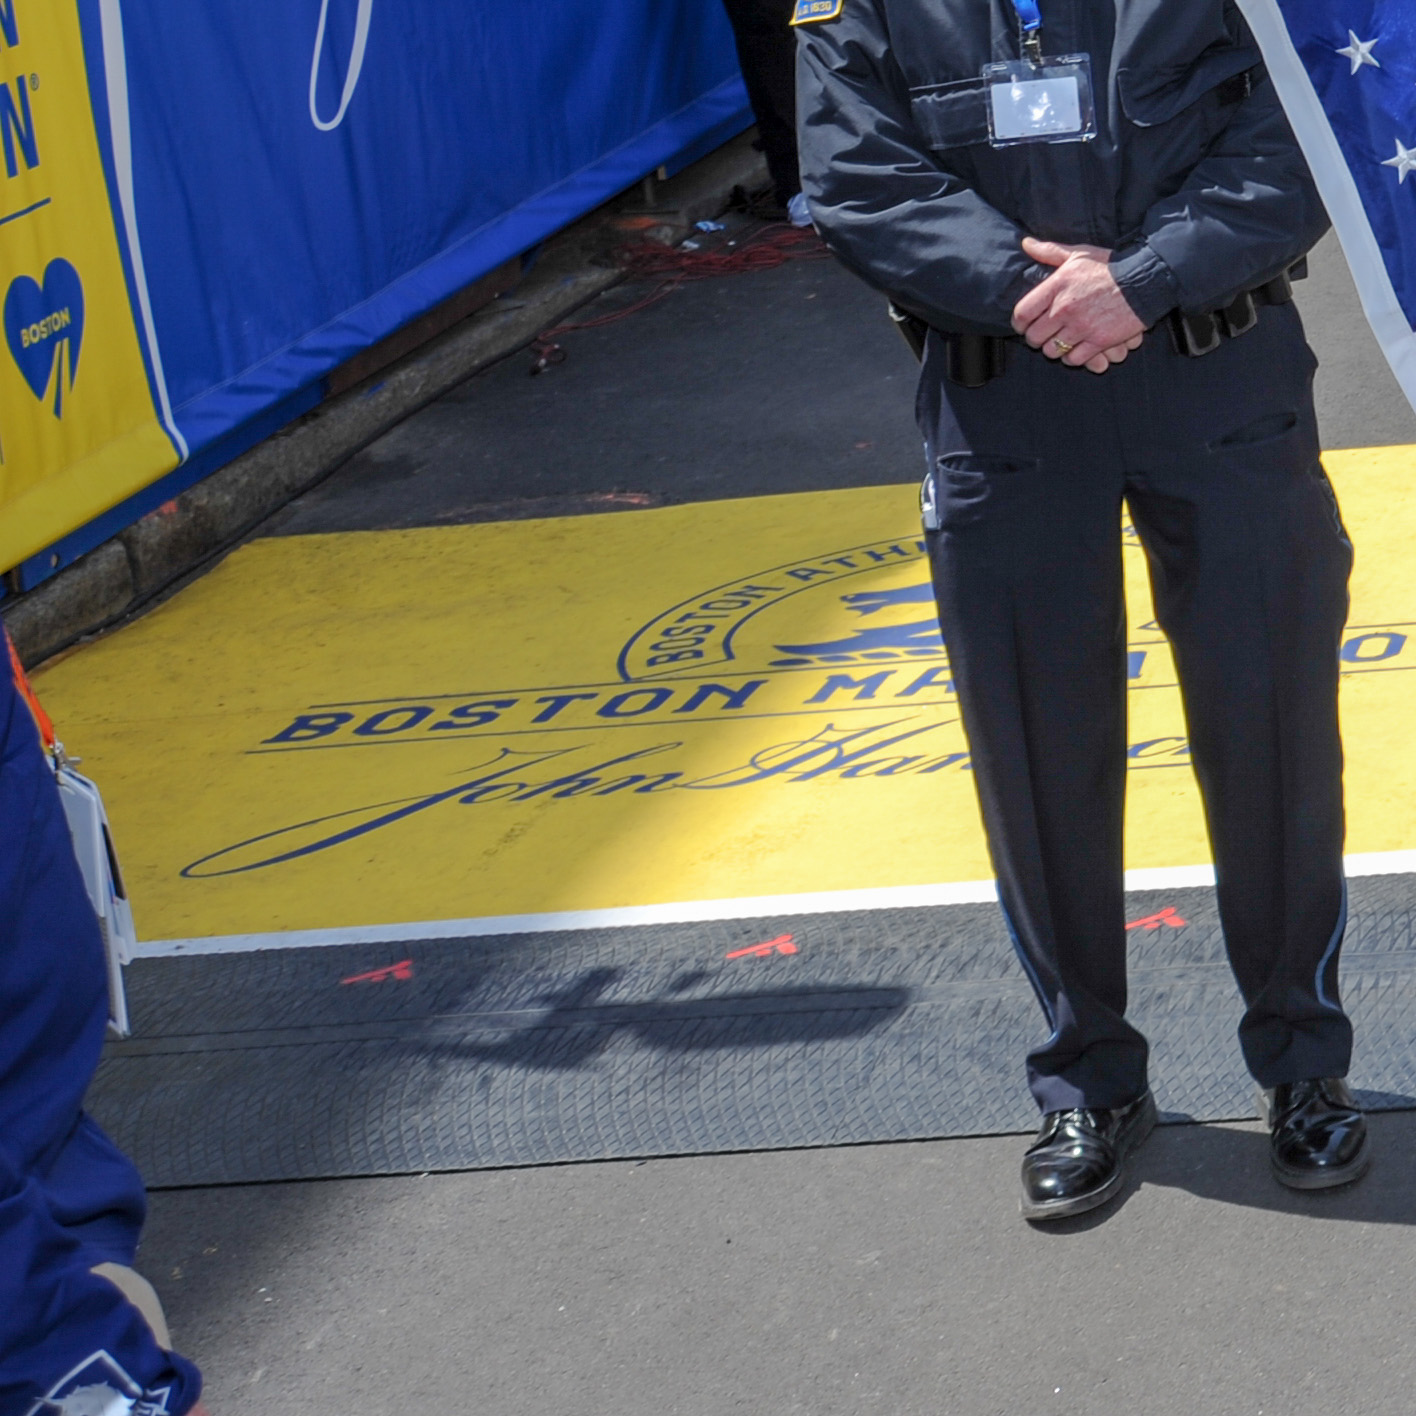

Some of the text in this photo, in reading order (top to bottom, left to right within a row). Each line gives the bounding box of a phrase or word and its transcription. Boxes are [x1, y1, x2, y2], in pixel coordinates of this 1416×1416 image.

[20, 306, 72, 350] BOSTON
[645, 583, 785, 668] BOSTON
[260, 679, 770, 745] BOSTON
[180, 741, 685, 878] John
